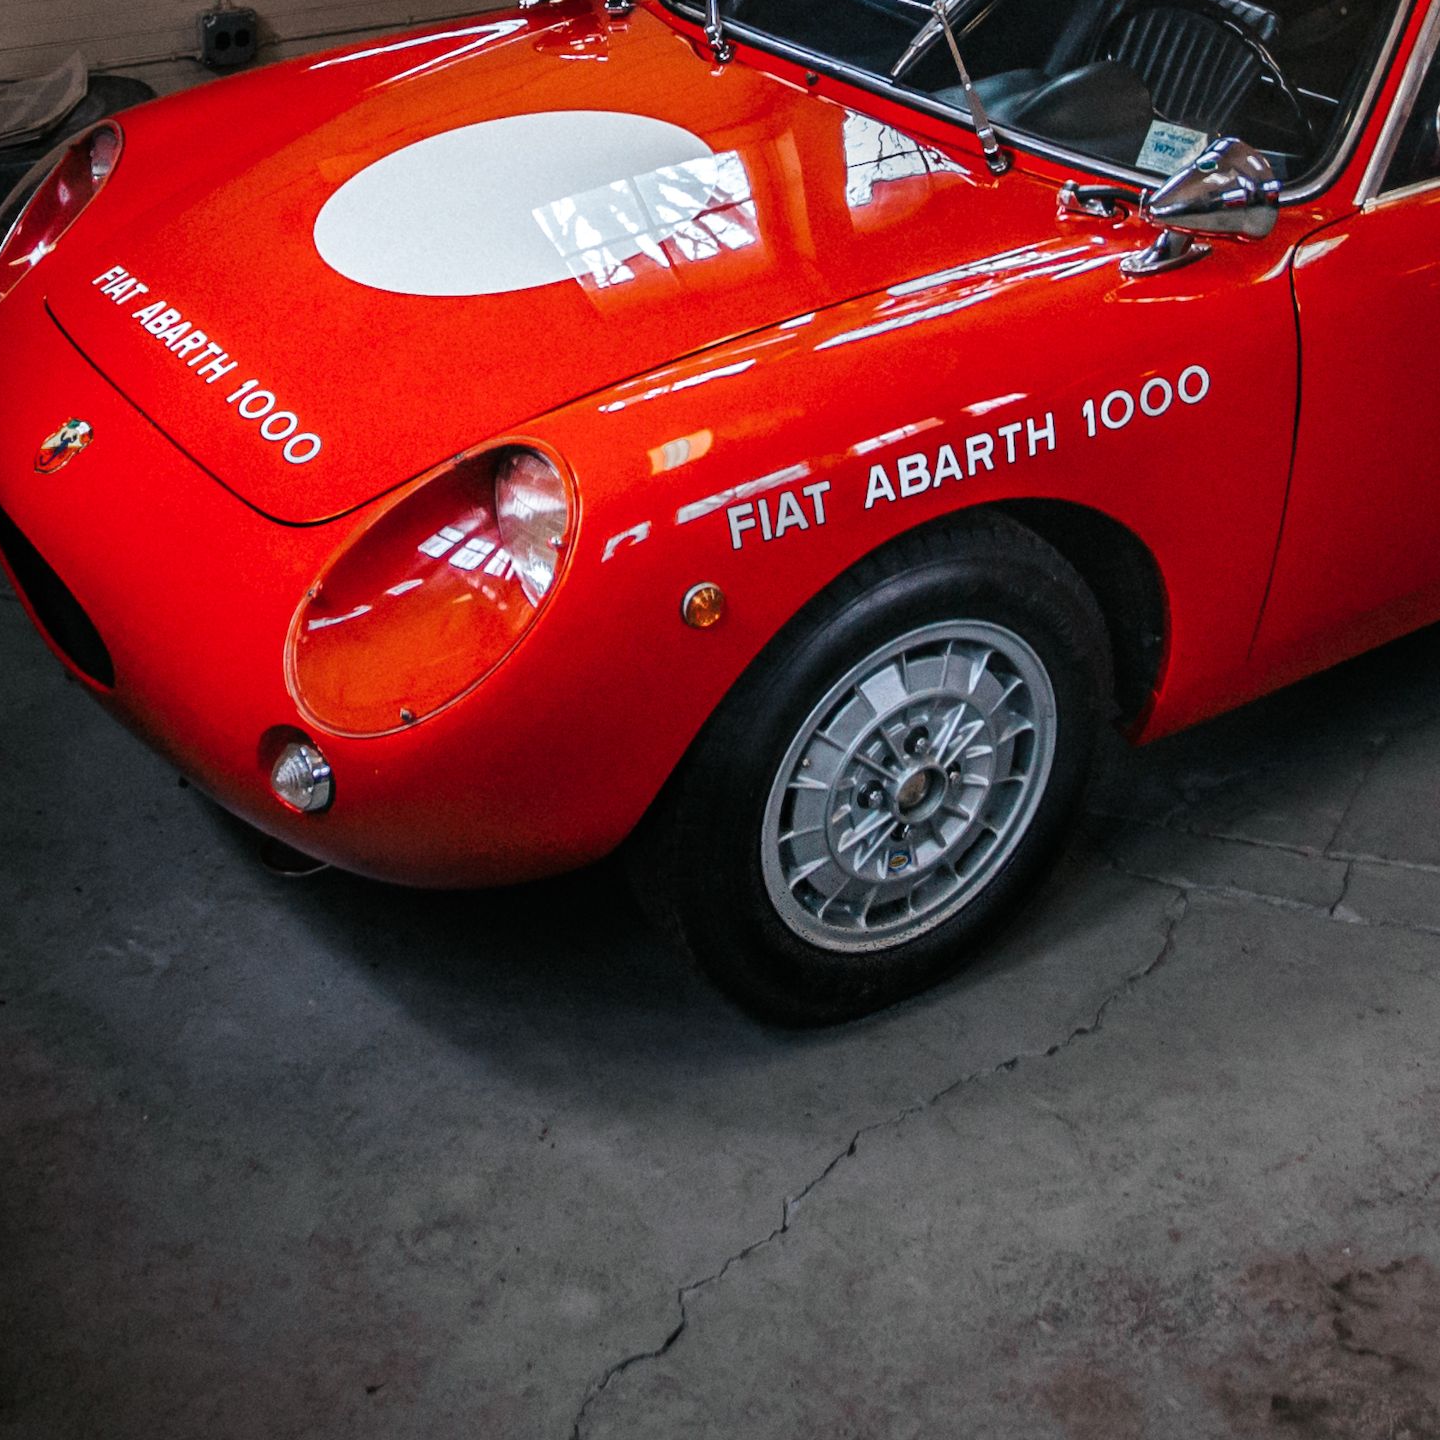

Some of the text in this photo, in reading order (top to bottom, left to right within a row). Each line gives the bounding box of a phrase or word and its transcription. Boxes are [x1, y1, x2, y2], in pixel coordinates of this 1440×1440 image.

[91, 264, 323, 465] FIAT ABARTH 1000
[727, 364, 1211, 550] FIAT ABARTH 1000
